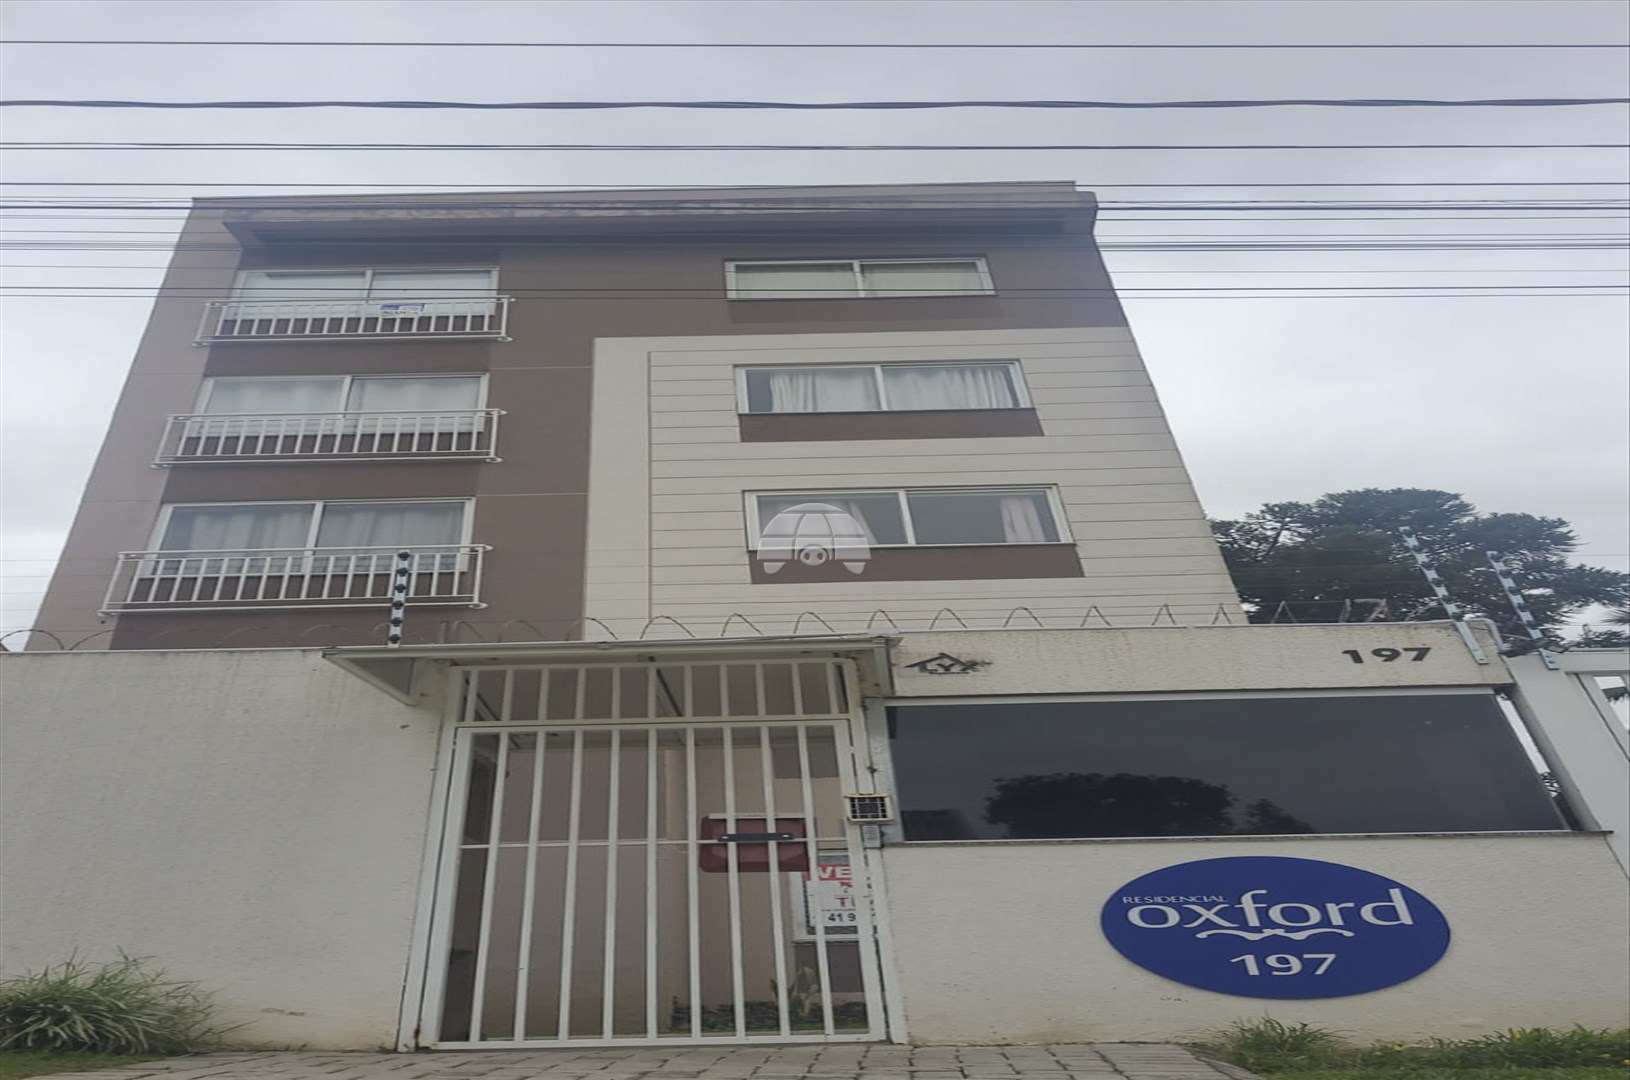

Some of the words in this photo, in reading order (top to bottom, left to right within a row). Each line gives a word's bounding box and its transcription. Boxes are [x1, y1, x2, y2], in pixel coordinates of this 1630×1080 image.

[1341, 647, 1432, 664] 197
[1122, 895, 1227, 904] RESIDENCIAL
[827, 912, 844, 922] 41
[1126, 888, 1414, 929] oxford
[1229, 953, 1337, 976] 197
